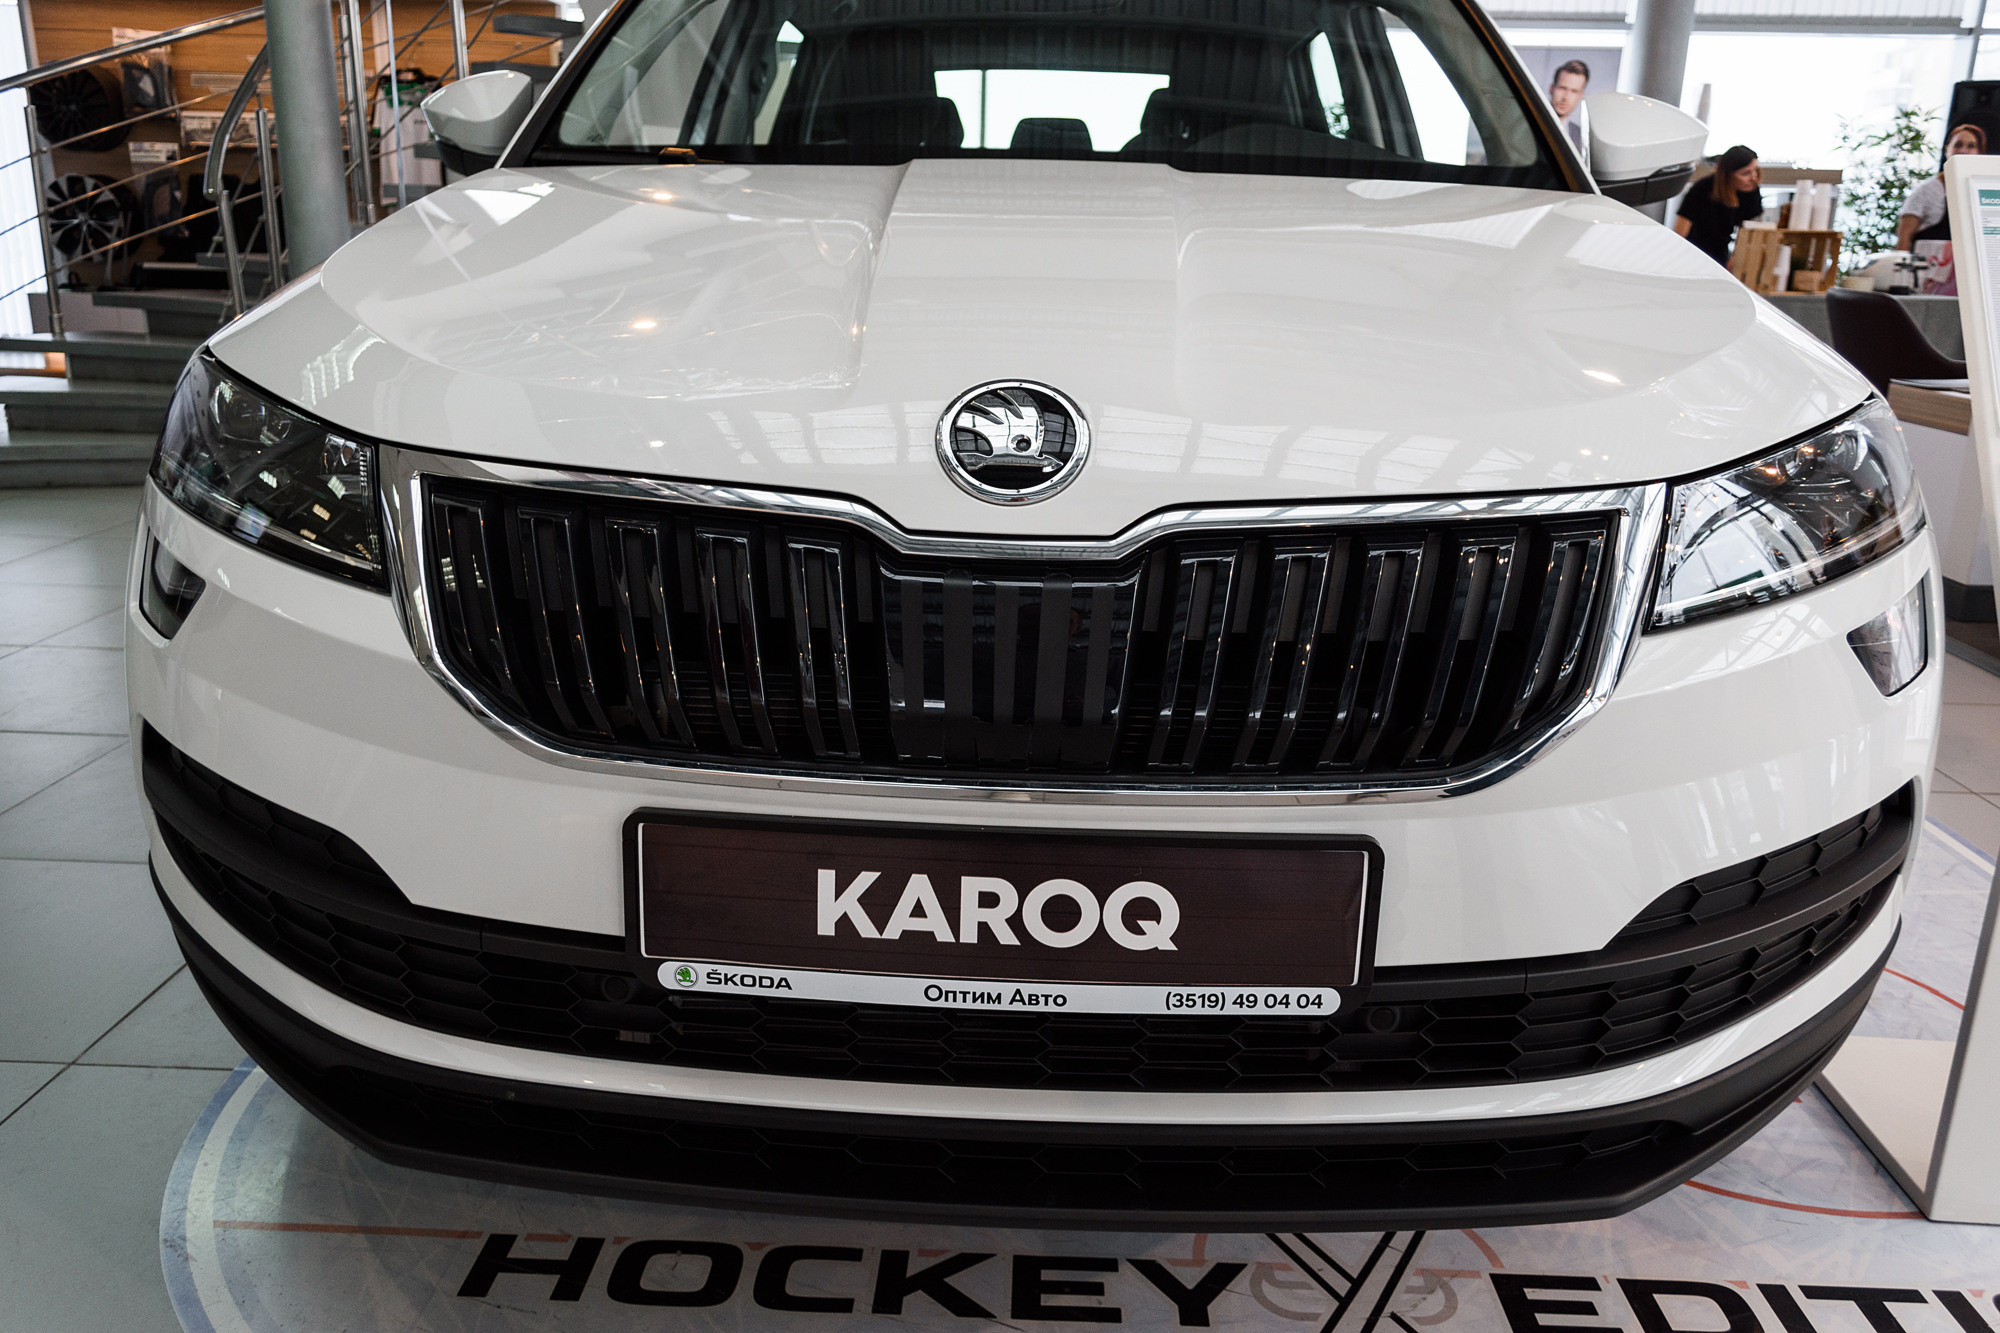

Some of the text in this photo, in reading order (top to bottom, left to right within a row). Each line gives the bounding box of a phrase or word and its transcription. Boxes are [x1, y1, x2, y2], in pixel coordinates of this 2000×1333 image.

[816, 868, 1181, 951] KAROQ
[706, 969, 793, 991] ŠKODA
[923, 984, 1068, 1008] Оптим Авто
[1165, 991, 1324, 1012] (3519) 49 04 04
[456, 1233, 2000, 1333] HOCKEY EDITI
